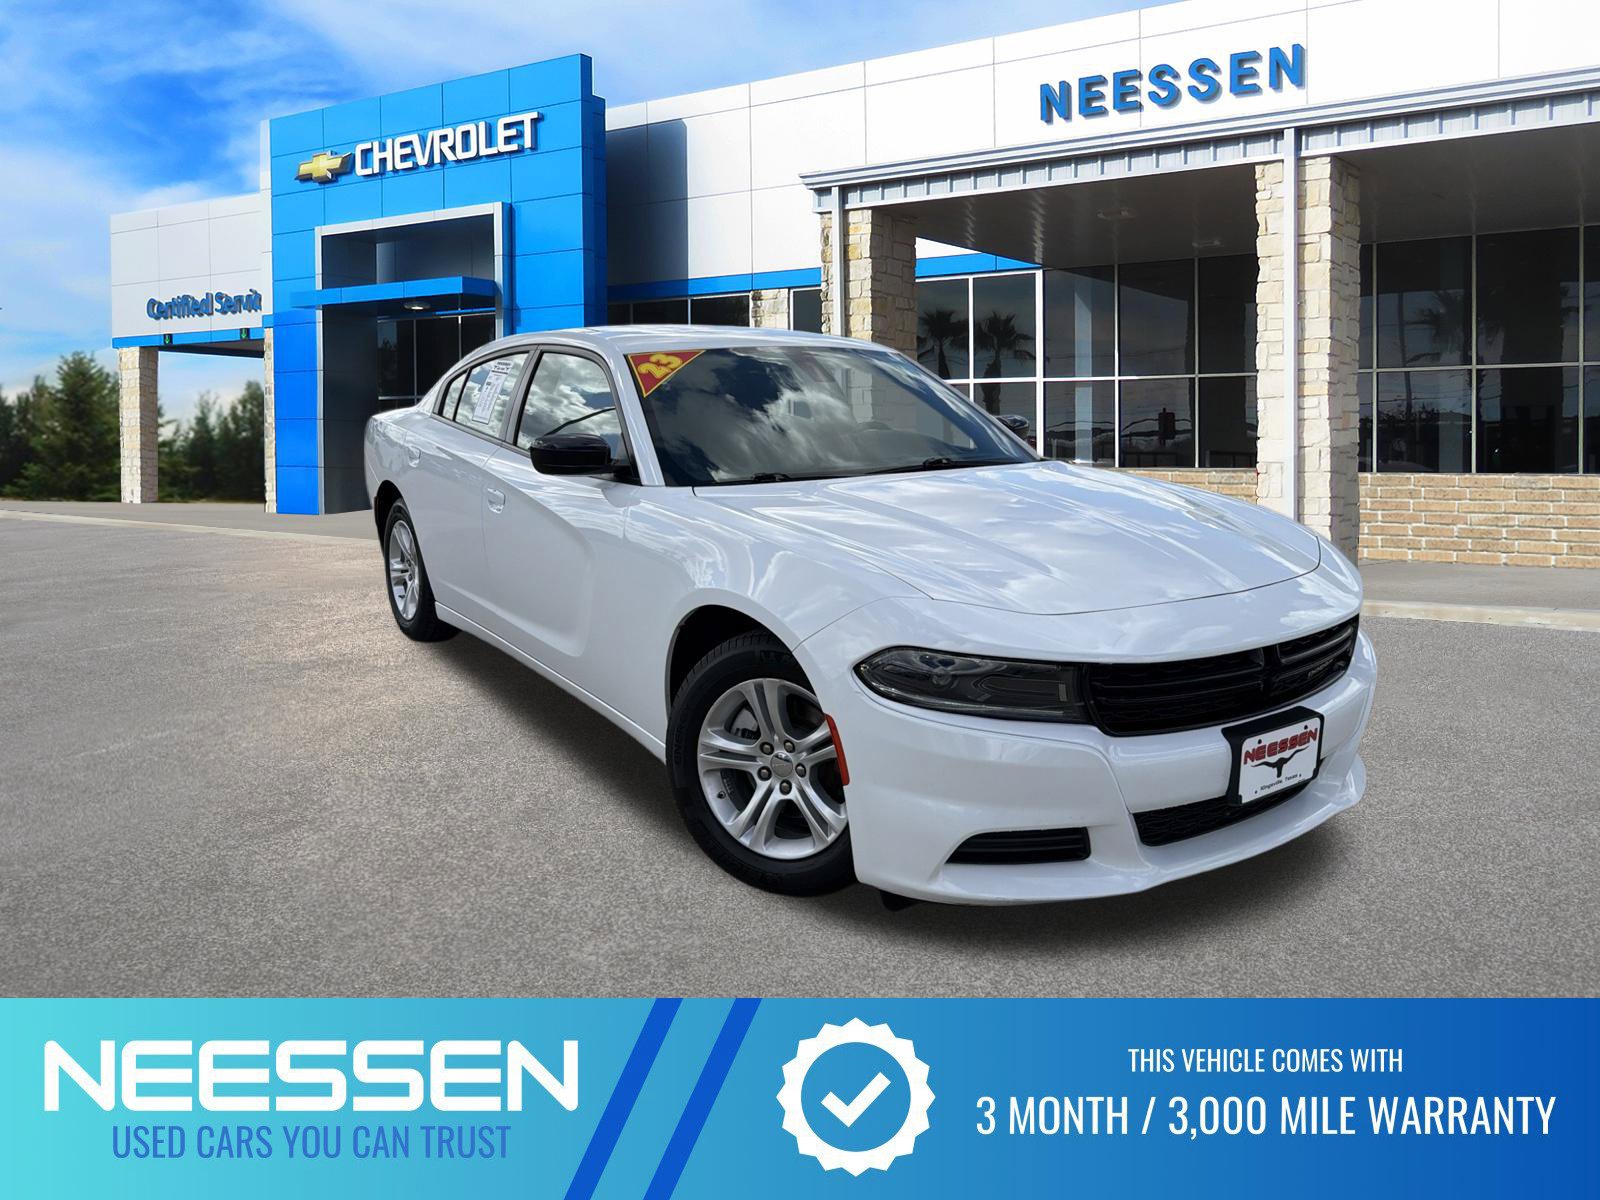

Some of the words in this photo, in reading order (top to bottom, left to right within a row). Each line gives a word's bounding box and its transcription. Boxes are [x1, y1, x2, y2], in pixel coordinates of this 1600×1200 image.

[1039, 43, 1305, 124] NEESSEN
[354, 111, 543, 177] CHEVROLET
[146, 292, 214, 320] Certified
[637, 352, 684, 379] 23
[1243, 727, 1319, 765] NEESSEN
